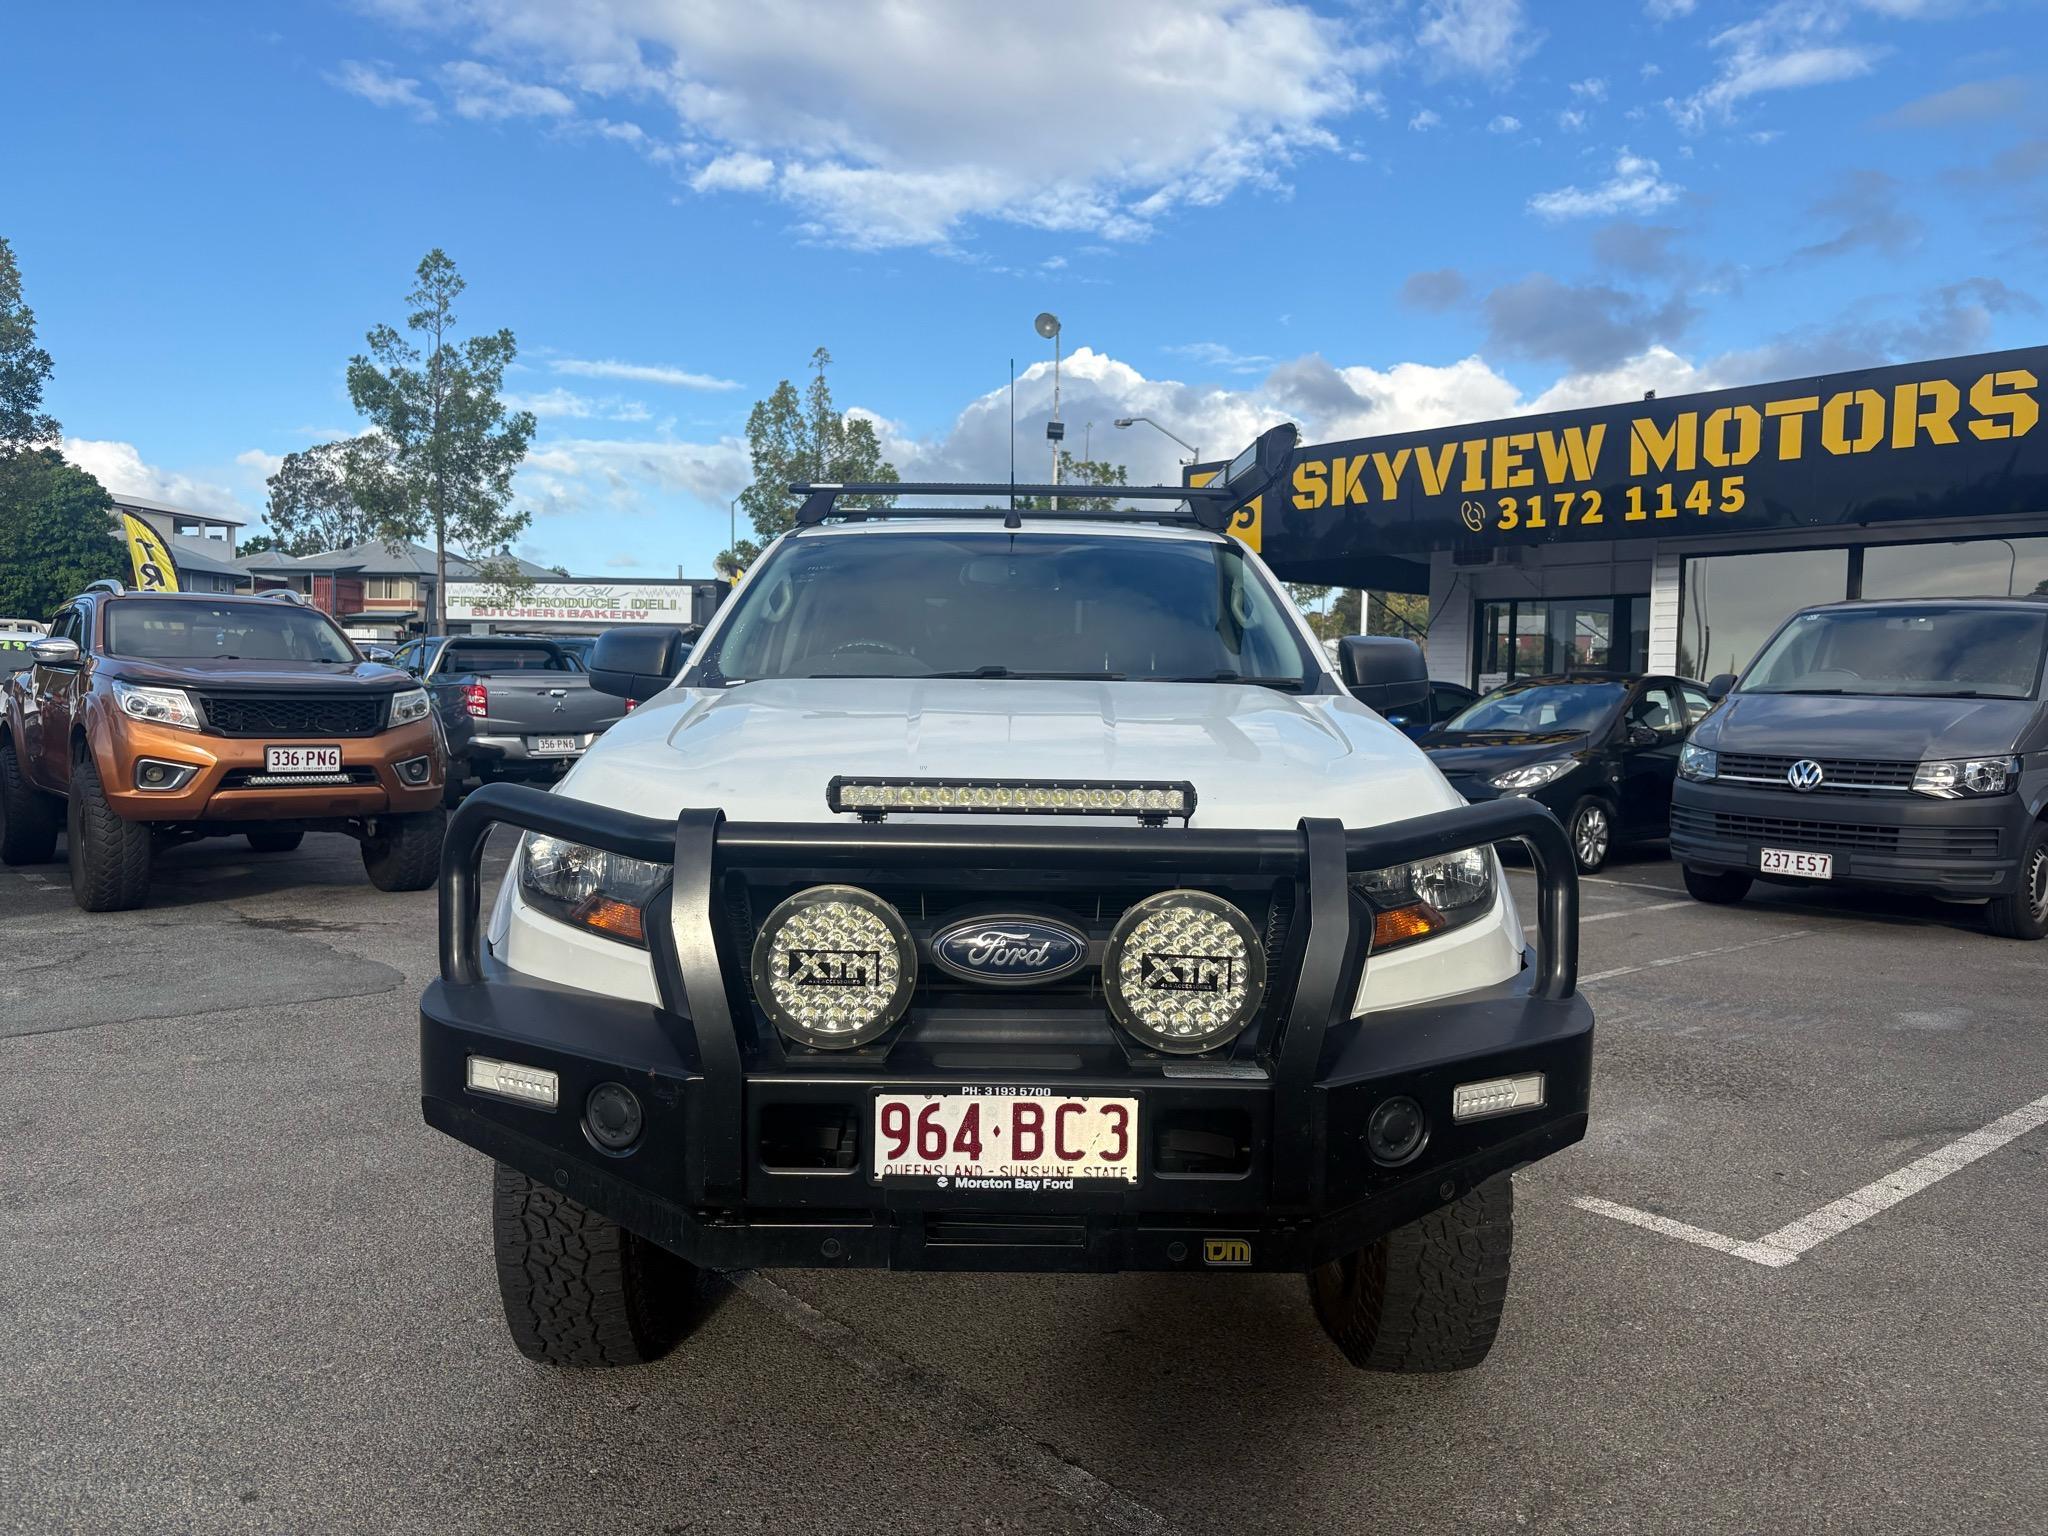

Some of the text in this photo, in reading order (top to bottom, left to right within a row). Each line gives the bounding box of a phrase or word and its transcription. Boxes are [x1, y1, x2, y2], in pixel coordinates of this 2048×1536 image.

[1292, 369, 2040, 510] SKYVIEW MOTORS
[1497, 476, 1746, 530] 3172 1145
[521, 597, 620, 610] PRODUCE
[471, 607, 555, 618] BUTCHER
[567, 609, 649, 620] BAKERY
[968, 931, 1050, 966] Ford
[962, 1086, 1051, 1097] PH: 3193 5700
[955, 1177, 1073, 1191] Moreton Bay Ford
